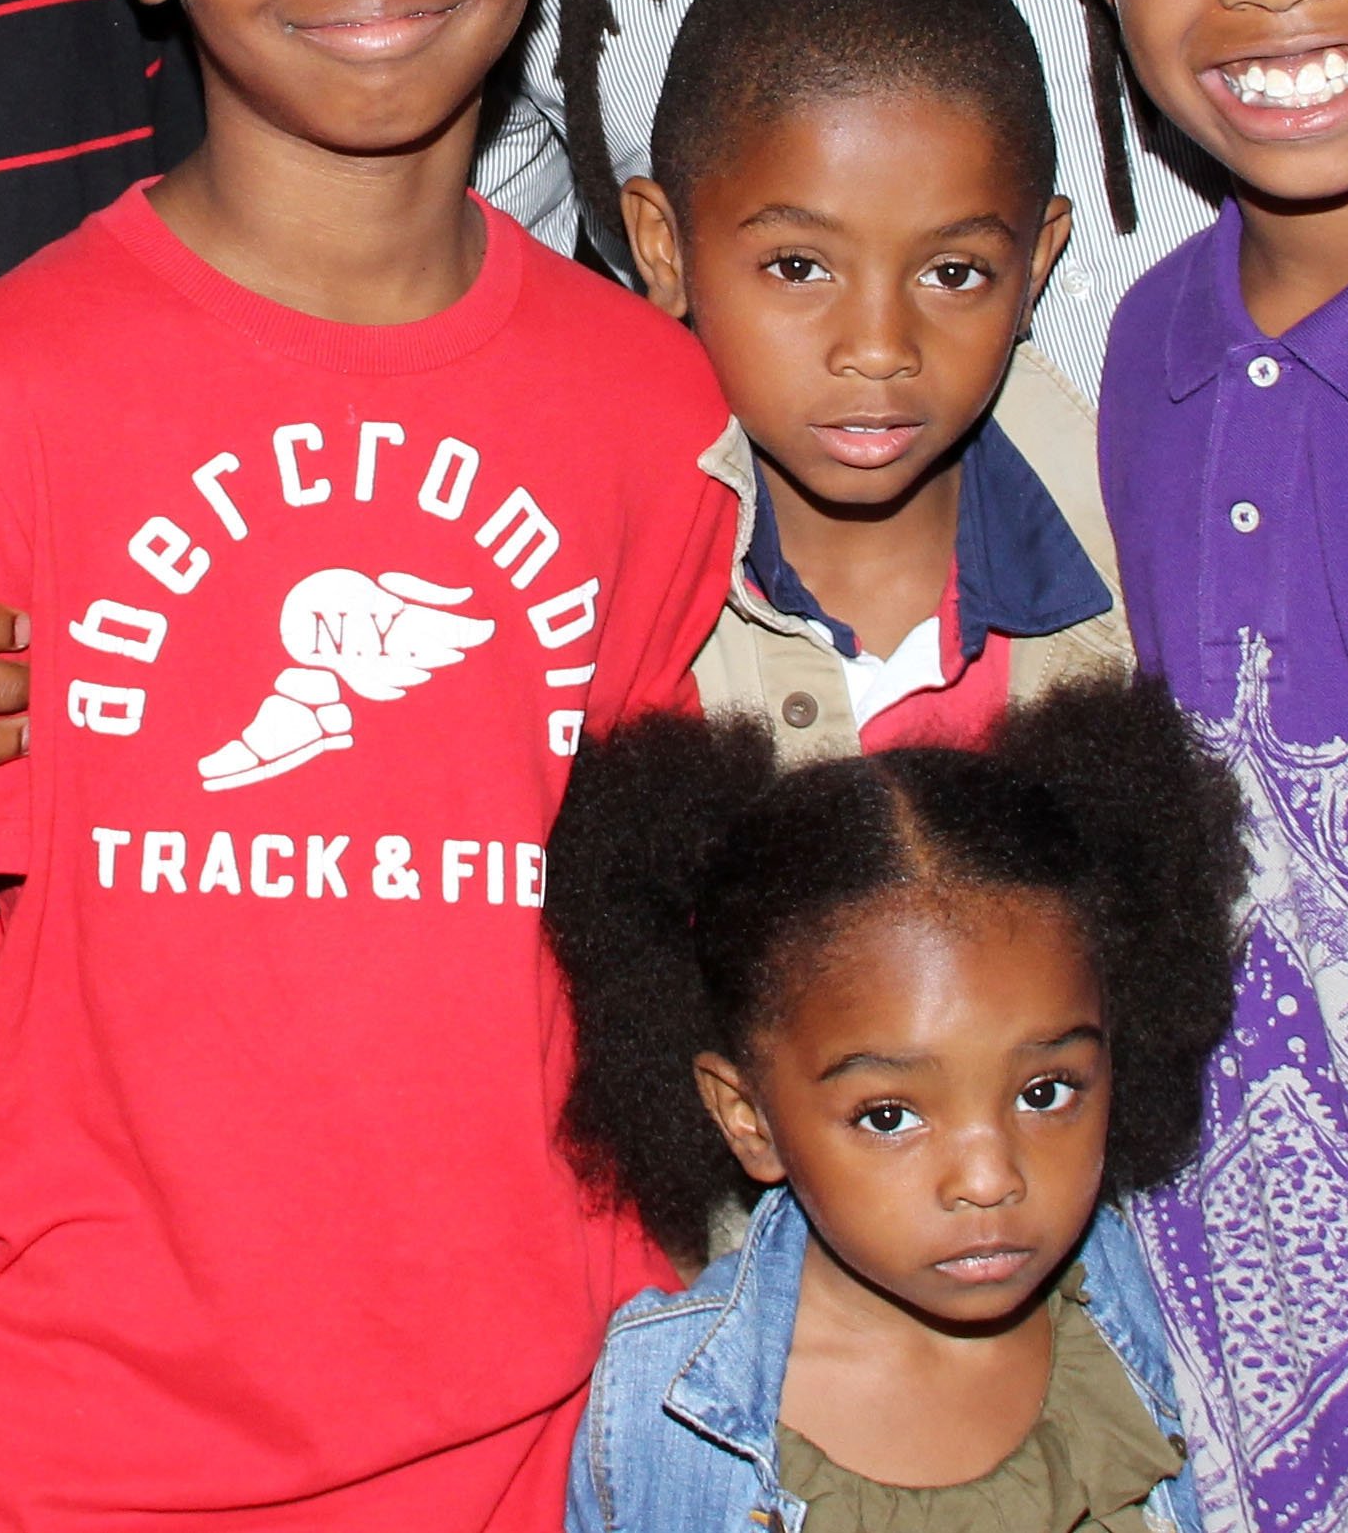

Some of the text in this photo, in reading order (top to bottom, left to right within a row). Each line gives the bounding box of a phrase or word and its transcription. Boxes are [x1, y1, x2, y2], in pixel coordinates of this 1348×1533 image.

[92, 827, 547, 908] TRACK & FIE
